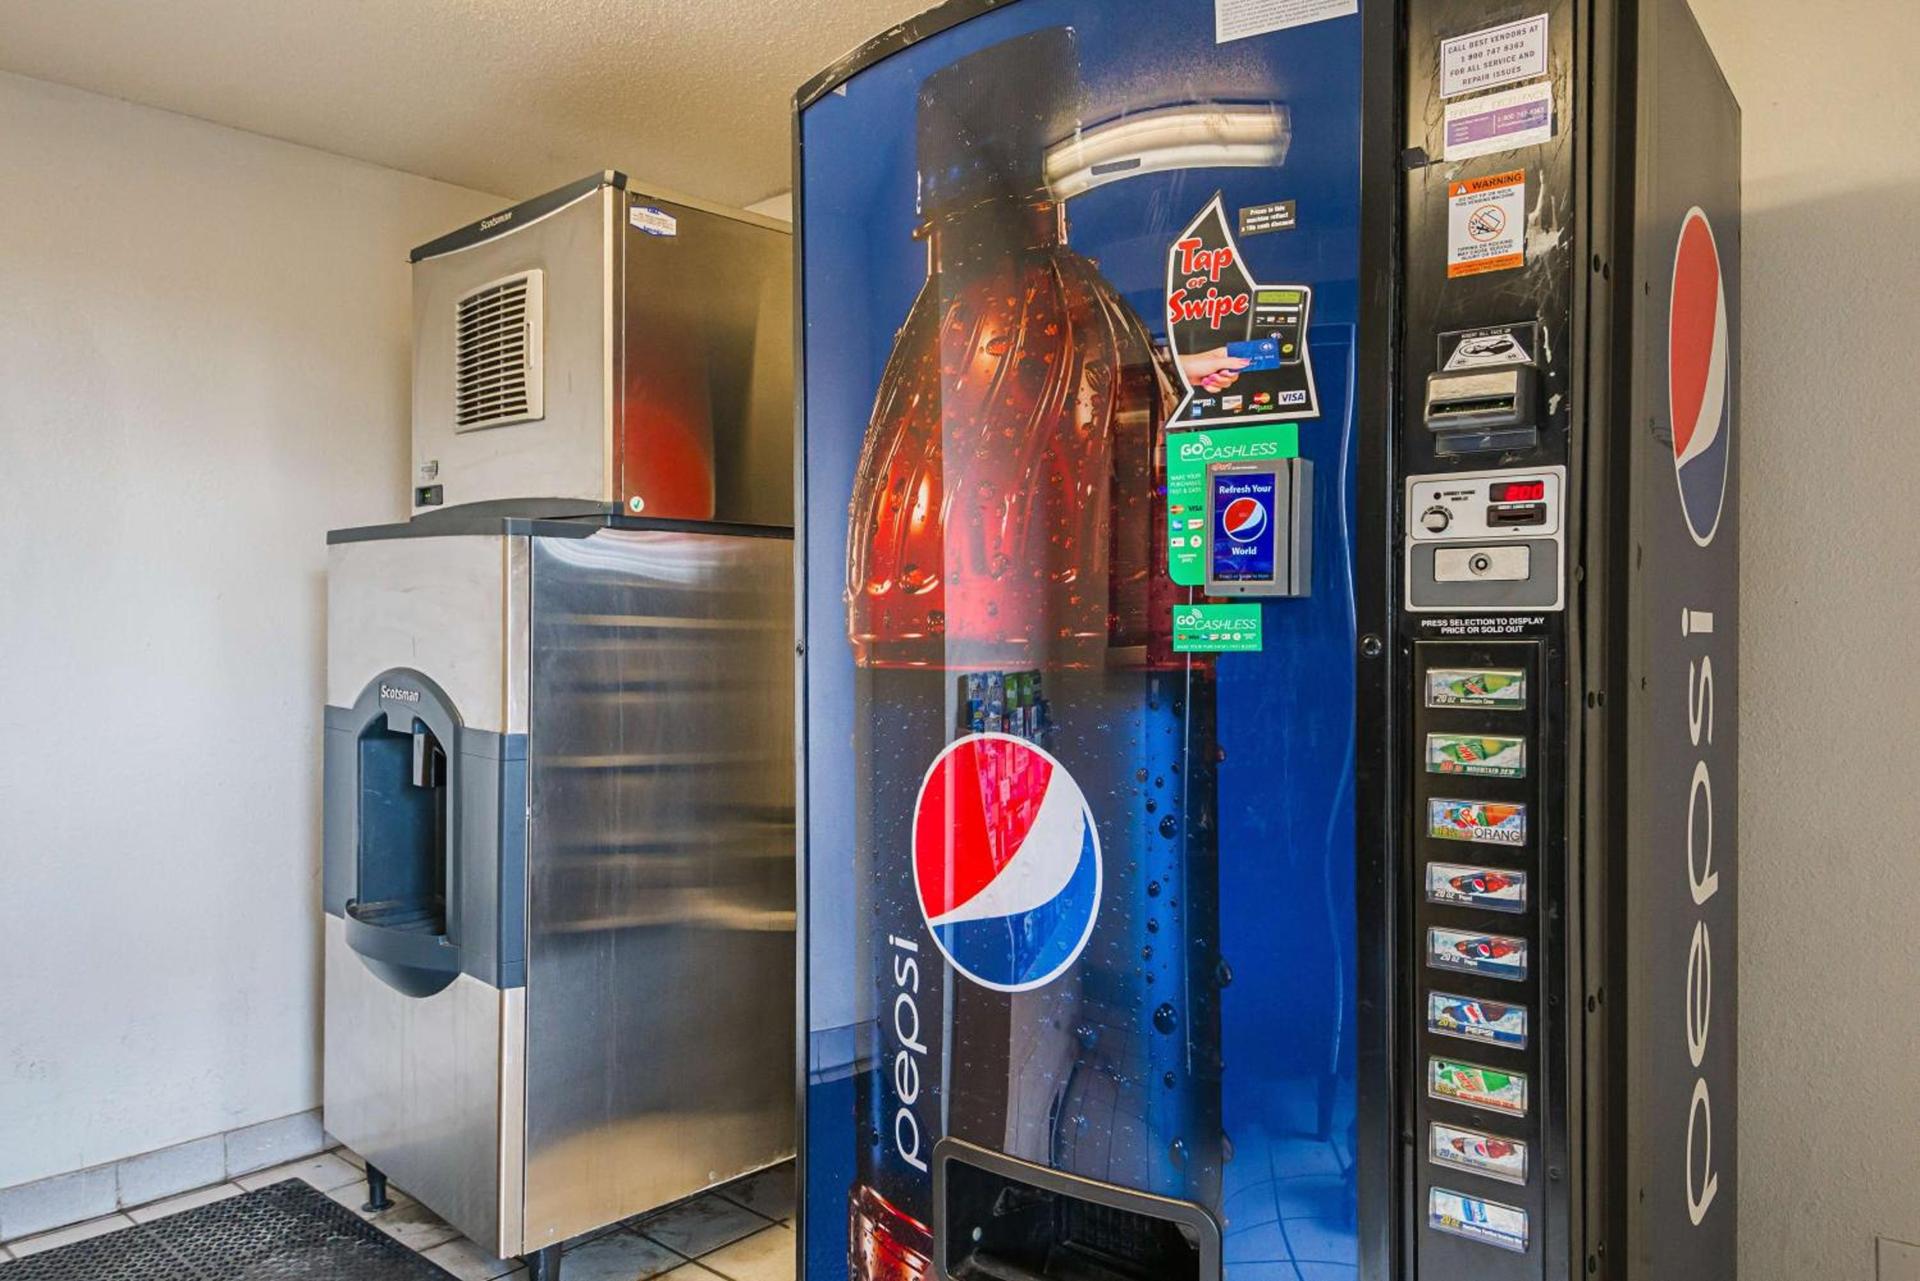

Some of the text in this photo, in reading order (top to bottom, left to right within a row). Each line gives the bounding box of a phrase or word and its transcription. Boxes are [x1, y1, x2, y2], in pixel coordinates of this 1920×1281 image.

[1448, 25, 1539, 54] CALL BEST VENDORS AT
[1450, 50, 1535, 77] FOR ALL SERVICE AND
[1462, 66, 1521, 85] REPAIR ISSUES
[1472, 173, 1522, 189] WARNING
[1177, 237, 1233, 283] Tap
[1186, 277, 1208, 289] or
[1168, 287, 1250, 330] Swipe
[1281, 392, 1305, 402] VISA
[1181, 441, 1278, 460] GO CASHLESS
[1219, 484, 1272, 494] Refresh Your
[1231, 546, 1258, 556] World
[1176, 614, 1257, 631] GO CASHLESS
[1421, 616, 1545, 627] PRESS SELECTION TO DISPLAY
[1441, 626, 1465, 634] PRICE
[1481, 625, 1504, 633] SOLD
[1505, 625, 1524, 633] OUT
[380, 684, 421, 702] Scotsman
[1435, 693, 1447, 703] 20
[1681, 607, 1719, 1227] pepsi
[889, 934, 928, 1173] pepsi
